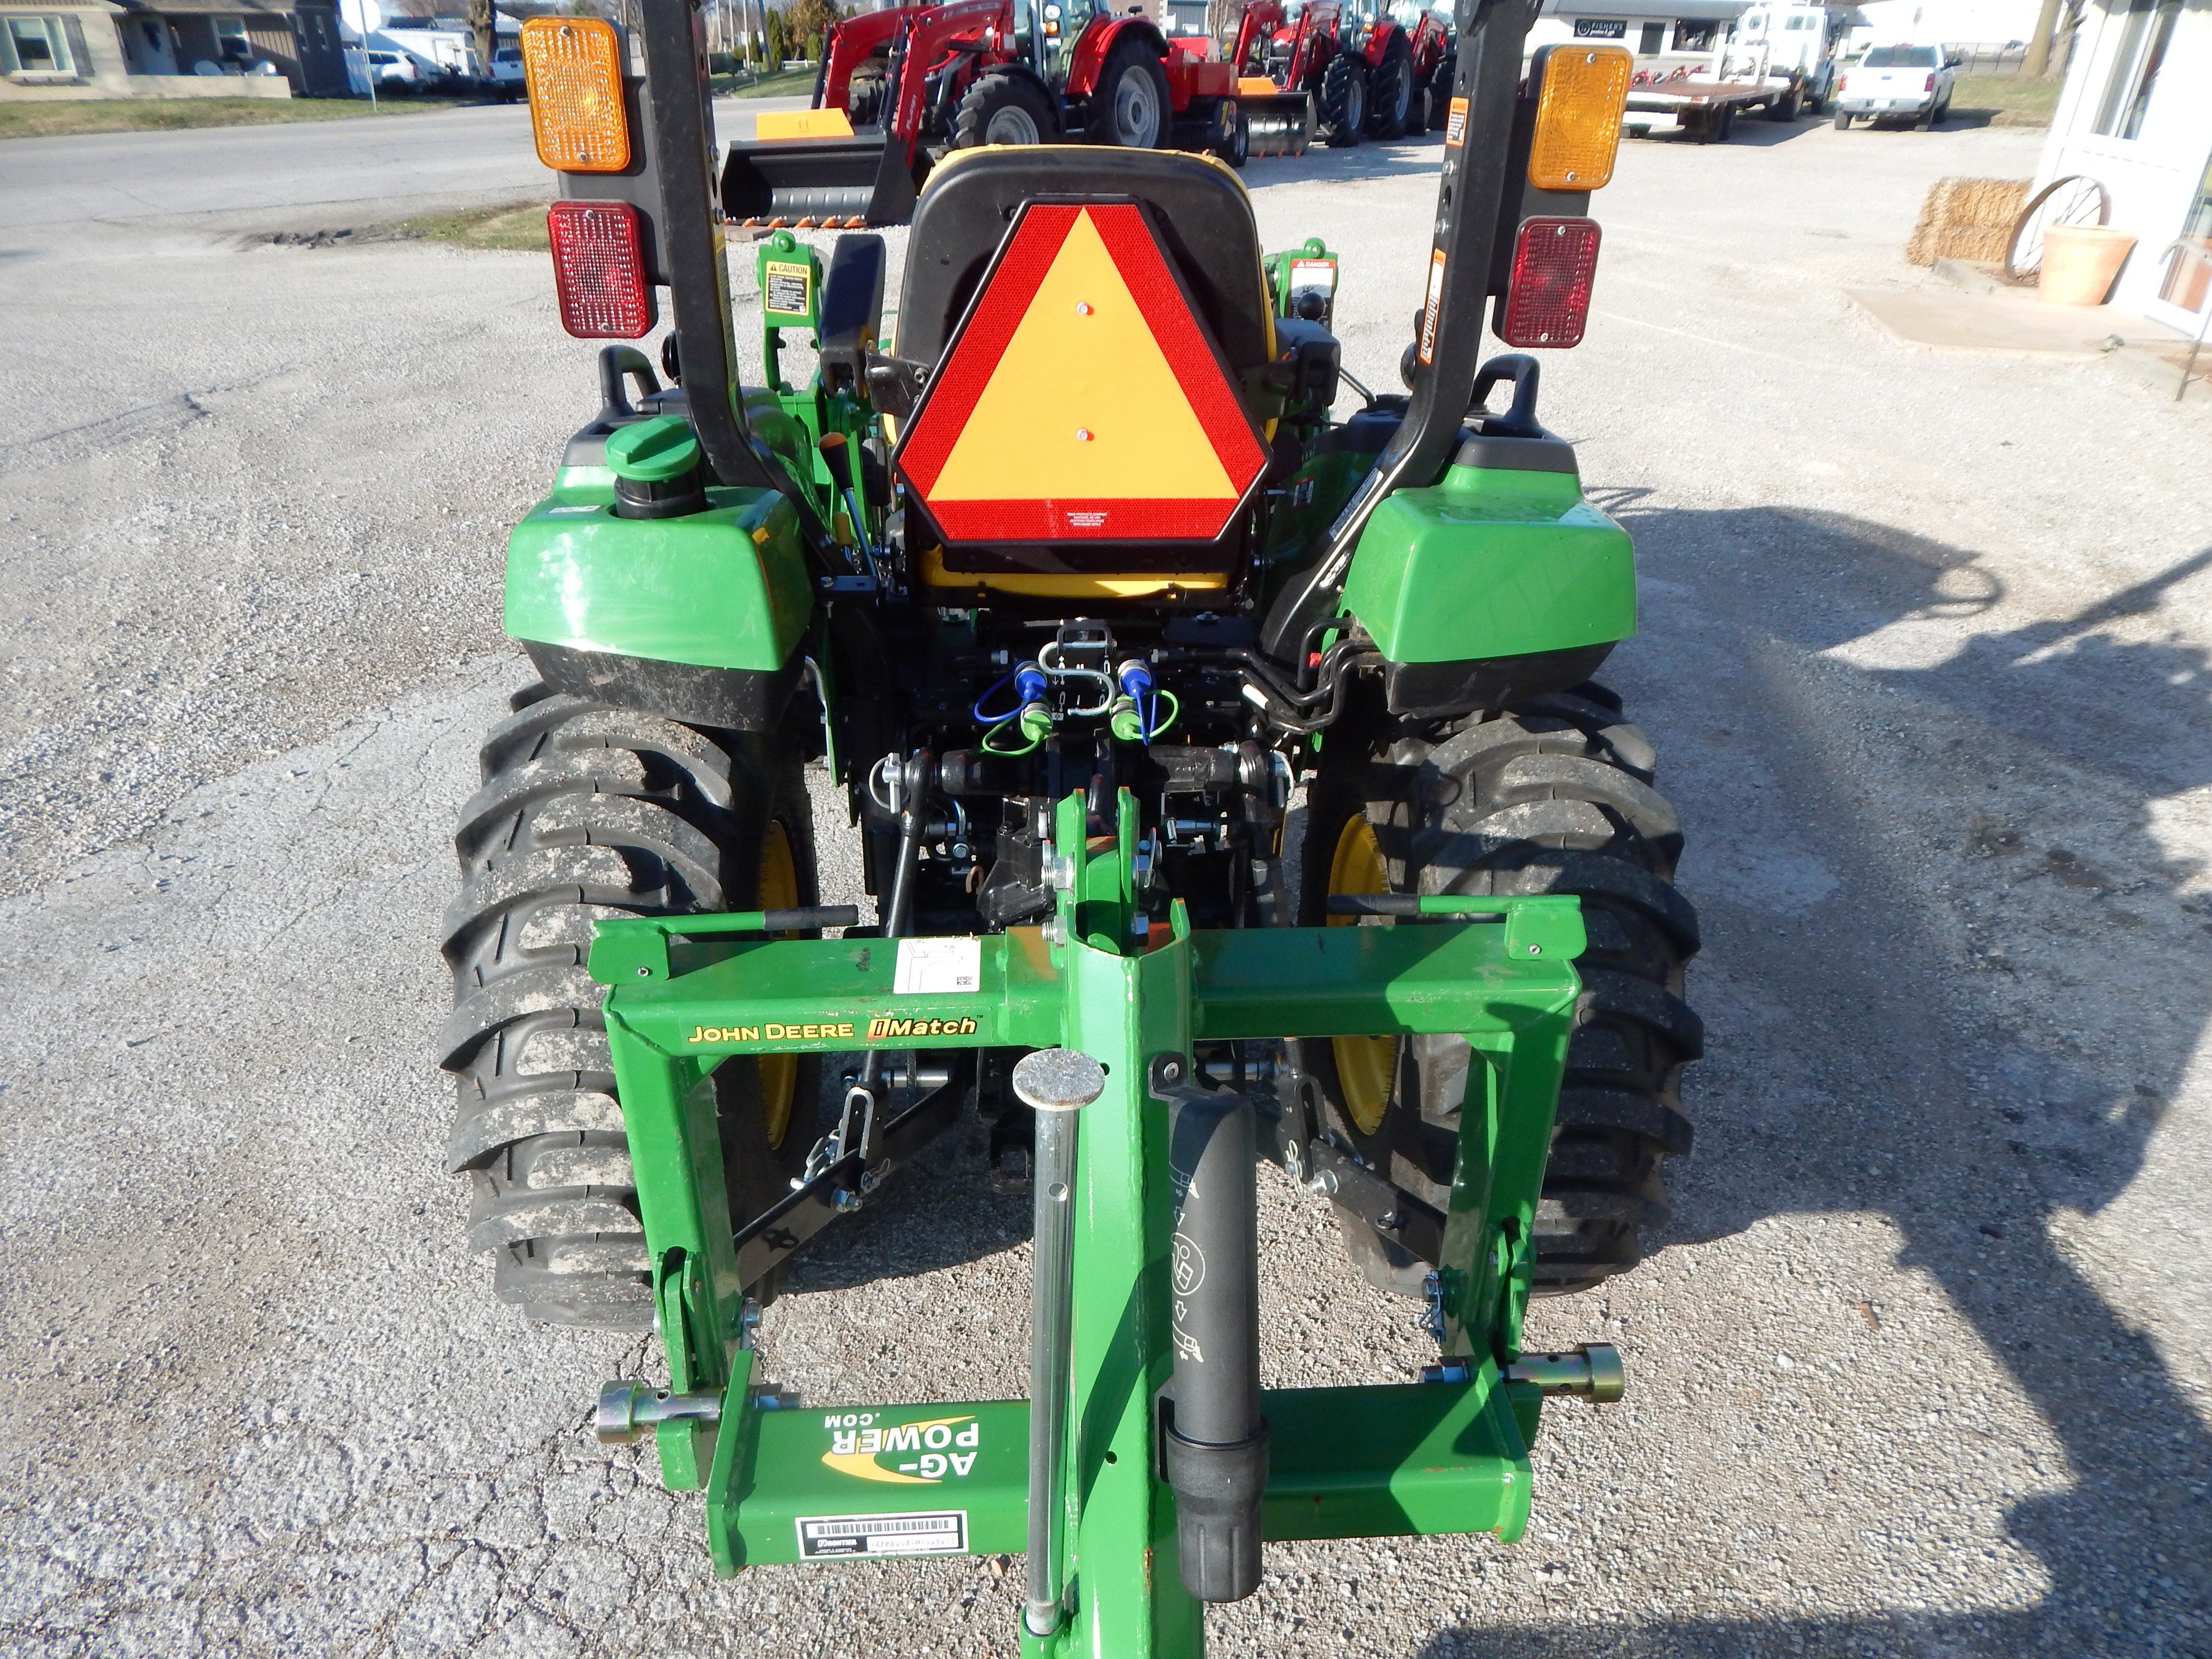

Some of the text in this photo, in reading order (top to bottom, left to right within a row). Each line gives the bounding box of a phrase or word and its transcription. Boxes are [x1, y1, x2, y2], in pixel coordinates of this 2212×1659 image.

[779, 264, 807, 275] CAUTION
[688, 1025, 759, 1043] JOHN
[766, 1023, 854, 1040] DEERE
[867, 1015, 978, 1039] iMatch
[824, 1413, 880, 1428] .COM
[831, 1422, 979, 1455] POWER
[899, 1451, 977, 1478] AG-
